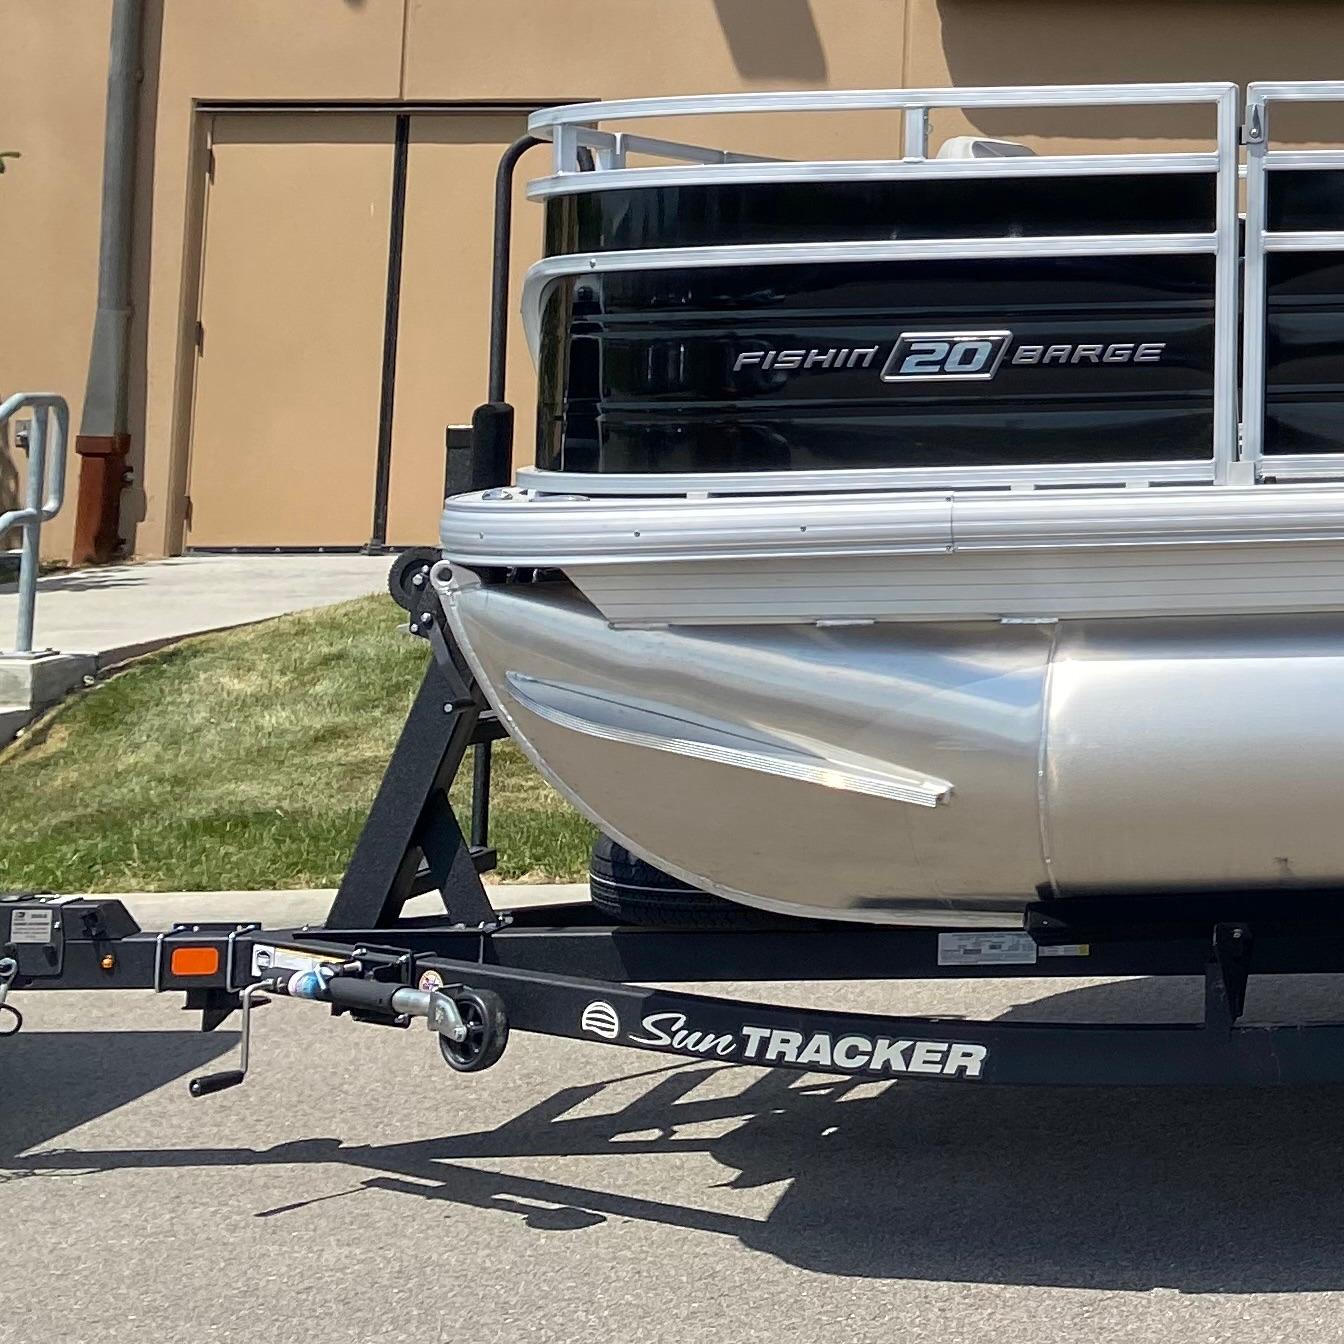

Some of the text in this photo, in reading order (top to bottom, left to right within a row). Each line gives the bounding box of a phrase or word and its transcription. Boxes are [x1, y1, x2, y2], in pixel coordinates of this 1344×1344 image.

[733, 341, 1166, 373] FISHIN 20 BARGE
[629, 1013, 988, 1077] Sun TRACKER
